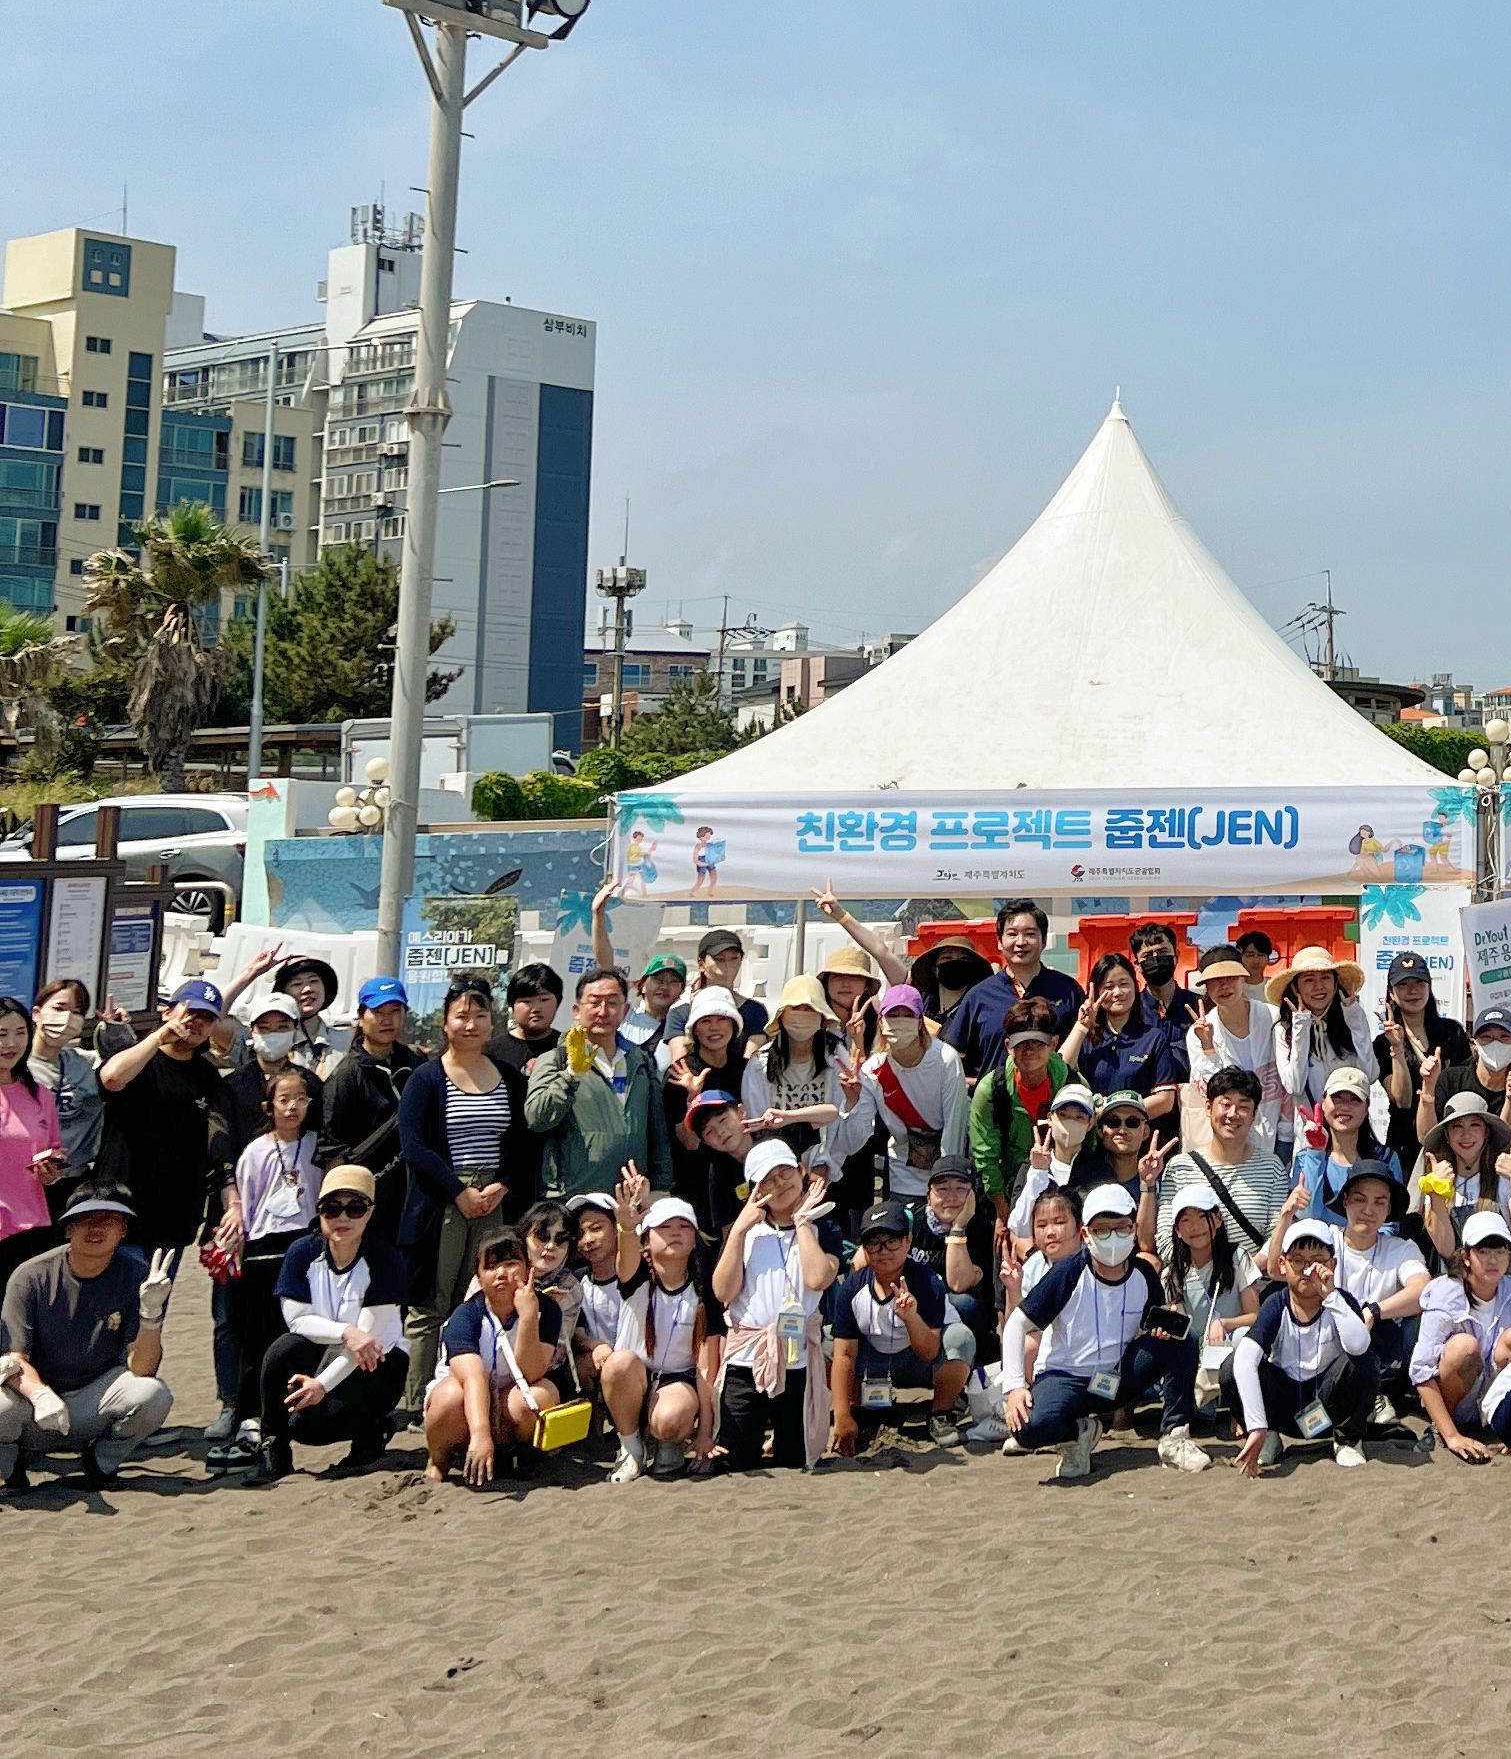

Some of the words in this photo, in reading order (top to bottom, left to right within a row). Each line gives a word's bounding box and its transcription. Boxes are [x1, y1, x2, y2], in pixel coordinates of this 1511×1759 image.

[544, 317, 587, 339] 삼부비치
[796, 810, 918, 851] 친환경
[929, 809, 1093, 850] 프로젝트
[1104, 805, 1299, 849] 줍젠(JEN)
[963, 869, 1026, 880] 제주특별자치도
